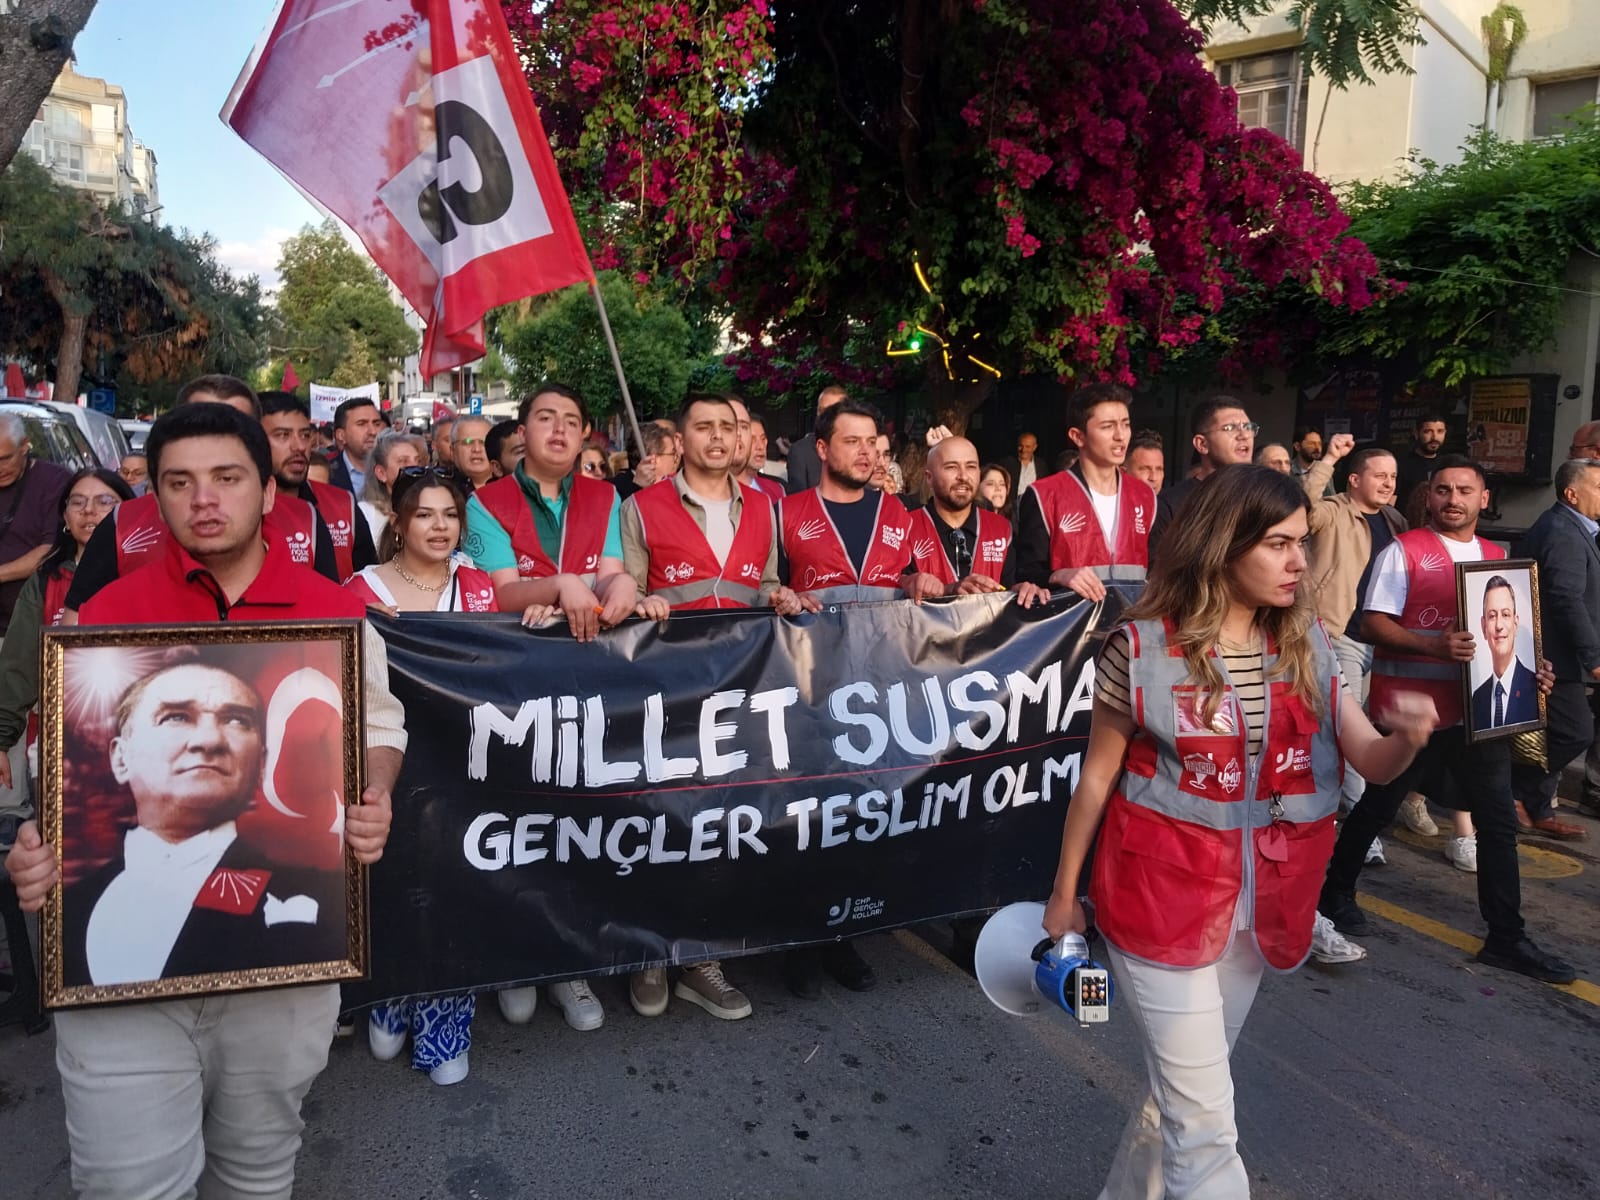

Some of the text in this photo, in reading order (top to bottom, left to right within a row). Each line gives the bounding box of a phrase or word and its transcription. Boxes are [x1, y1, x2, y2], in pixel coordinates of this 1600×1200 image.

[471, 398, 479, 414] P
[468, 533, 485, 558] 3
[468, 687, 799, 788] MİLLET
[463, 805, 769, 876] GENÇLER
[786, 774, 972, 851] TESLİM
[855, 897, 871, 906] CHP
